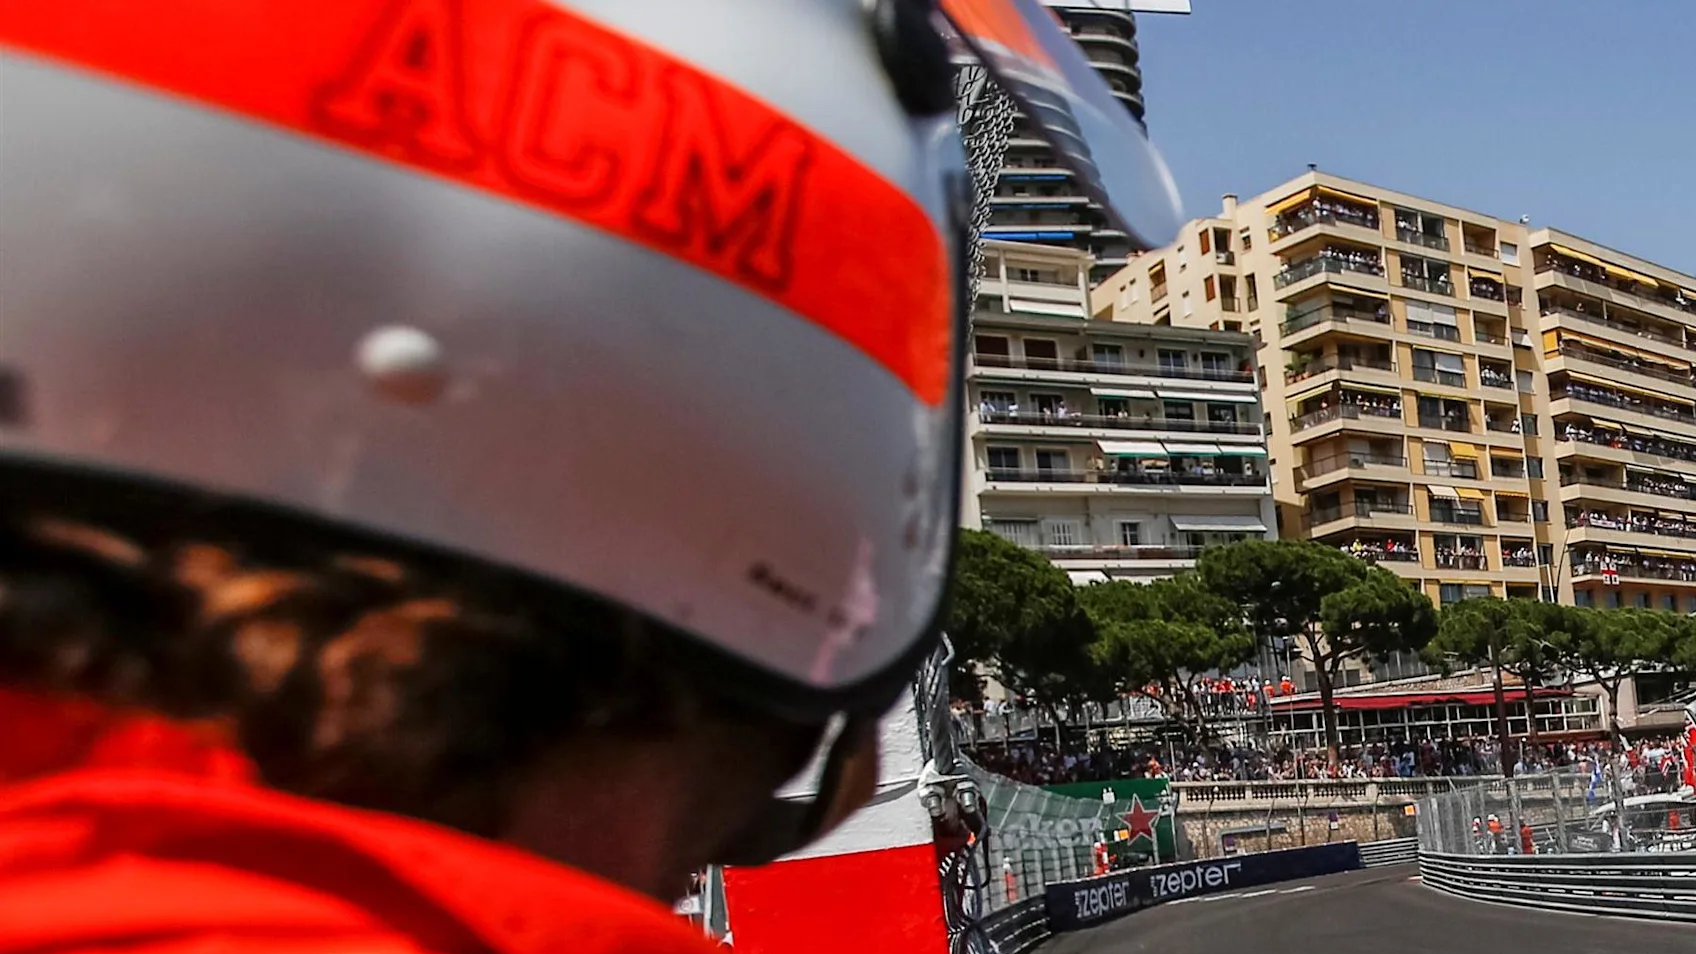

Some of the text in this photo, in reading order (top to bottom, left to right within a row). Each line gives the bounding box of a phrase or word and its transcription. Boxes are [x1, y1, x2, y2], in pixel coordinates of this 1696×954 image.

[312, 0, 818, 292] ACM
[1156, 861, 1241, 896] zepter
[1081, 881, 1129, 917] zepter
